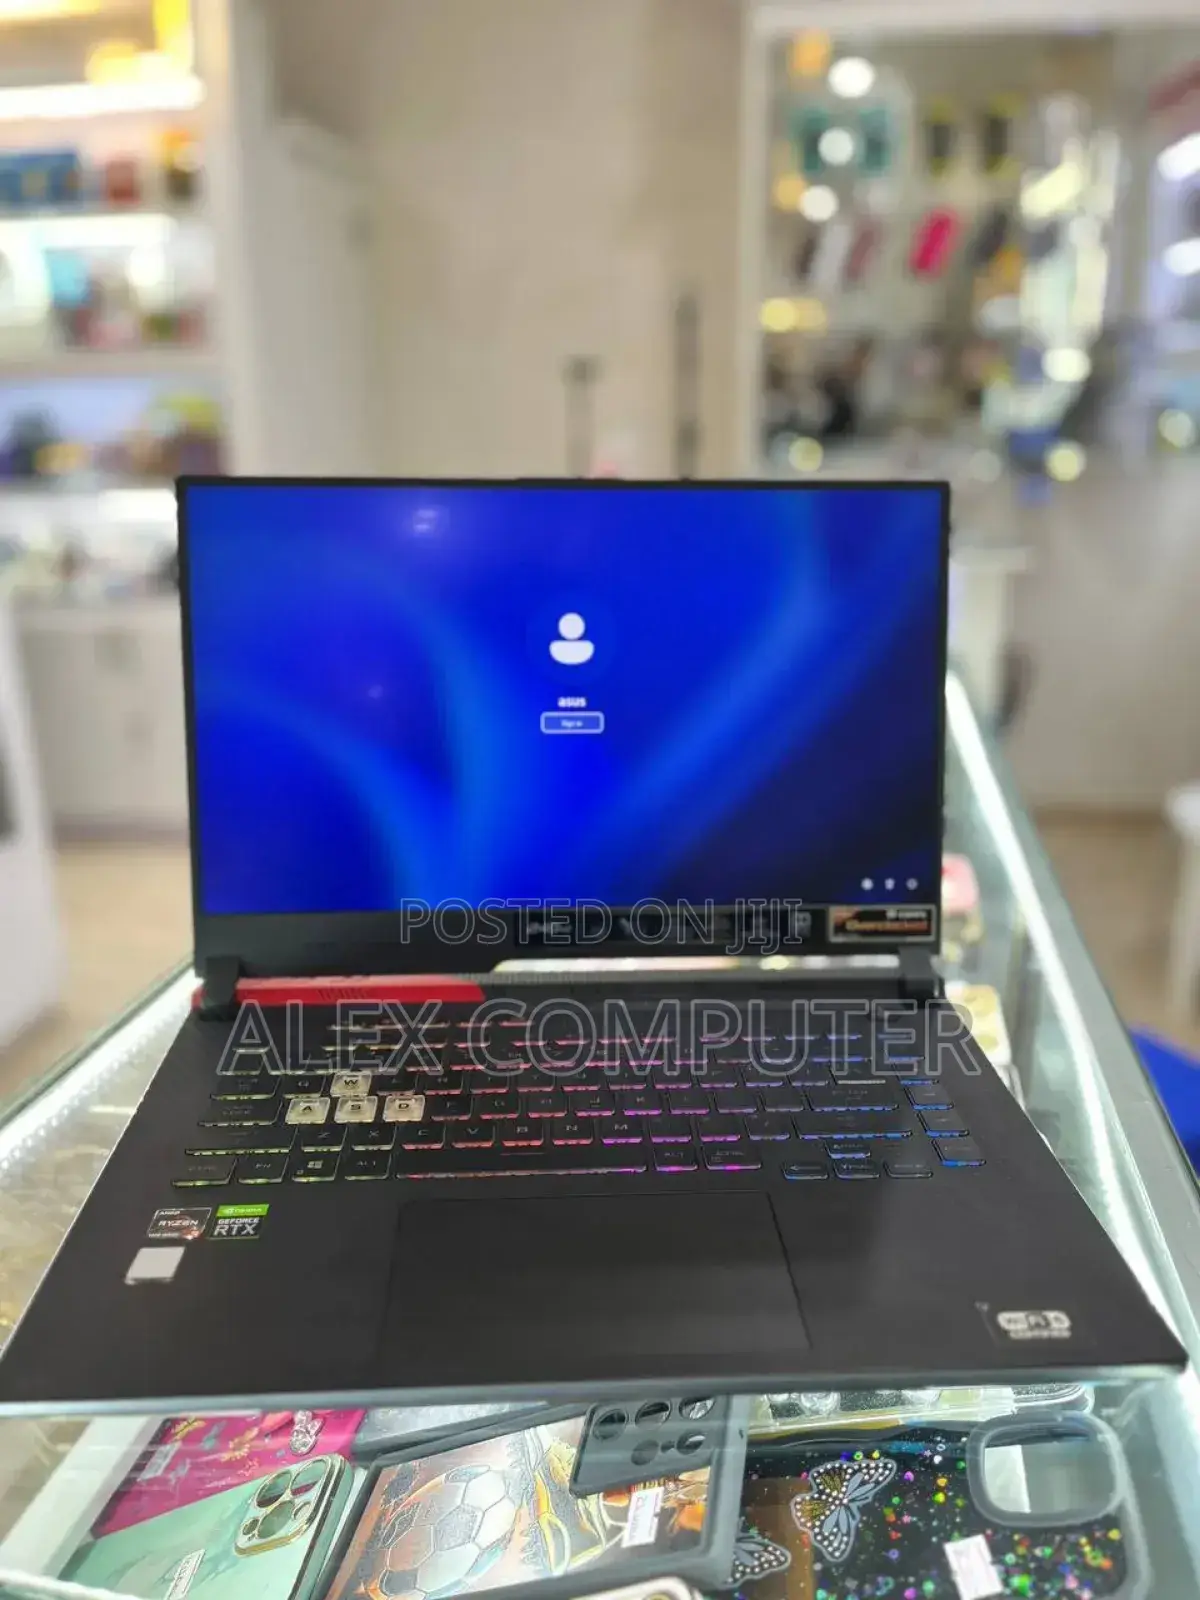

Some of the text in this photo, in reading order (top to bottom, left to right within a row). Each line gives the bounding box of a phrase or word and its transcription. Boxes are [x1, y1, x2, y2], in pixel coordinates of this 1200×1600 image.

[343, 1078, 359, 1087] W
[302, 1104, 313, 1112] A
[350, 1103, 361, 1111] S
[398, 1102, 409, 1110] D
[368, 1130, 380, 1138] X
[467, 1127, 480, 1135] V
[218, 1217, 260, 1225] GEFORCE
[213, 1223, 257, 1236] RTX
